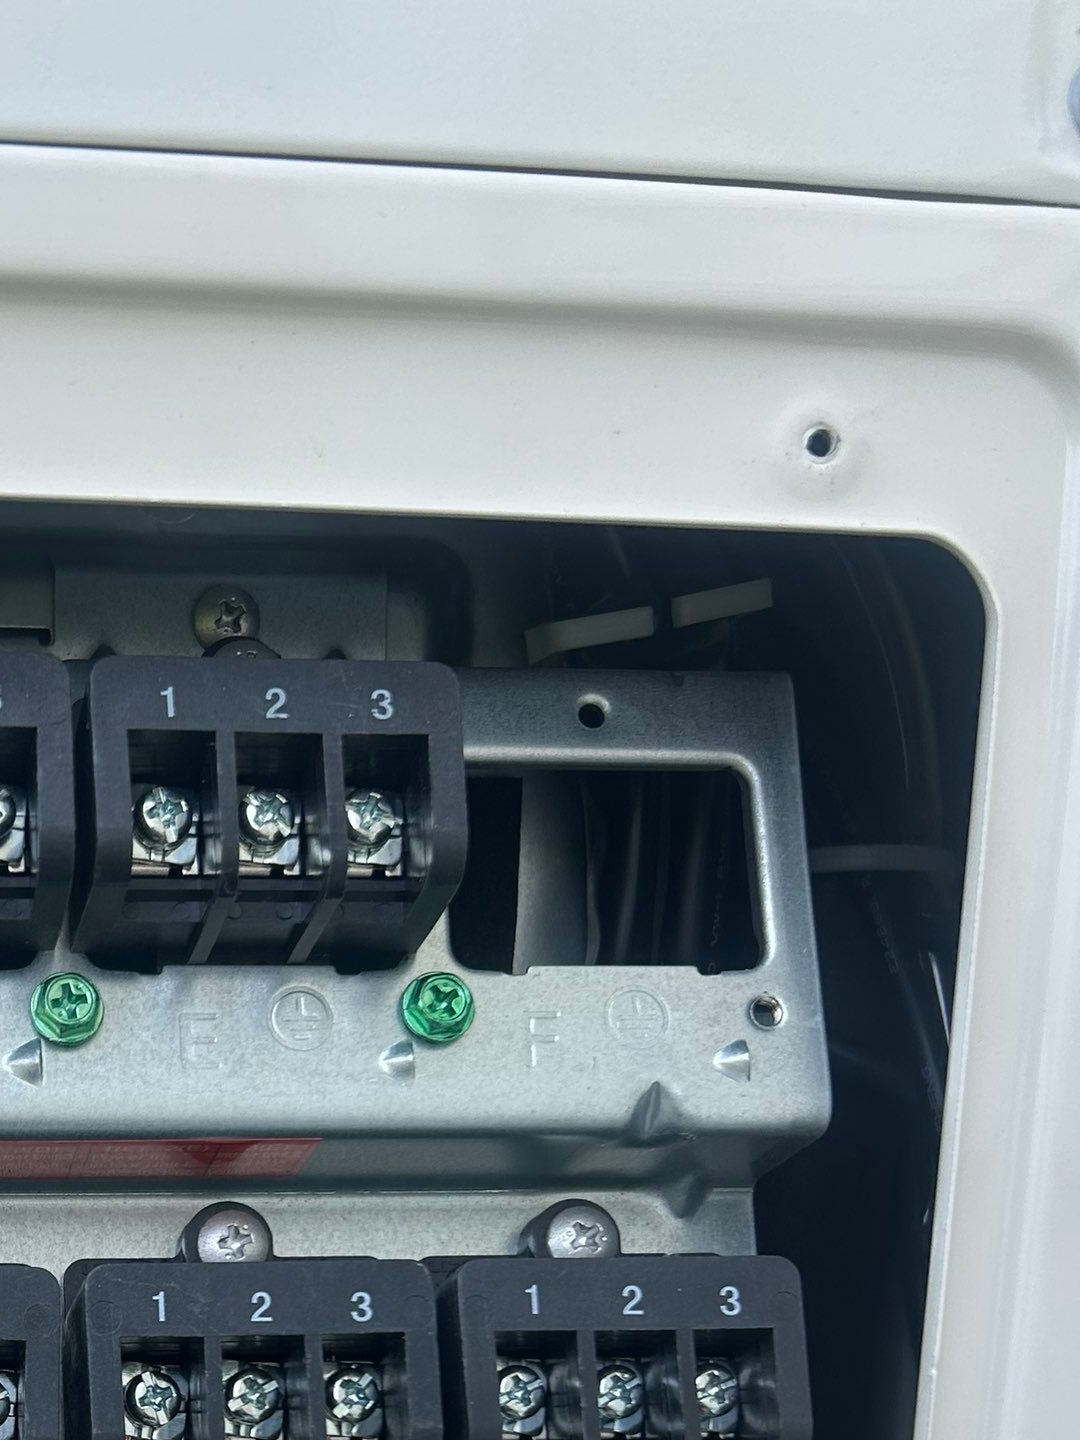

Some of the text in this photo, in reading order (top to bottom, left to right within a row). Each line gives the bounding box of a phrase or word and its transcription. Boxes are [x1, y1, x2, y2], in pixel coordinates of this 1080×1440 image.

[160, 686, 393, 720] 1 2 3
[152, 1291, 373, 1322] 1 2 3
[524, 1284, 742, 1316] 1 2 3
